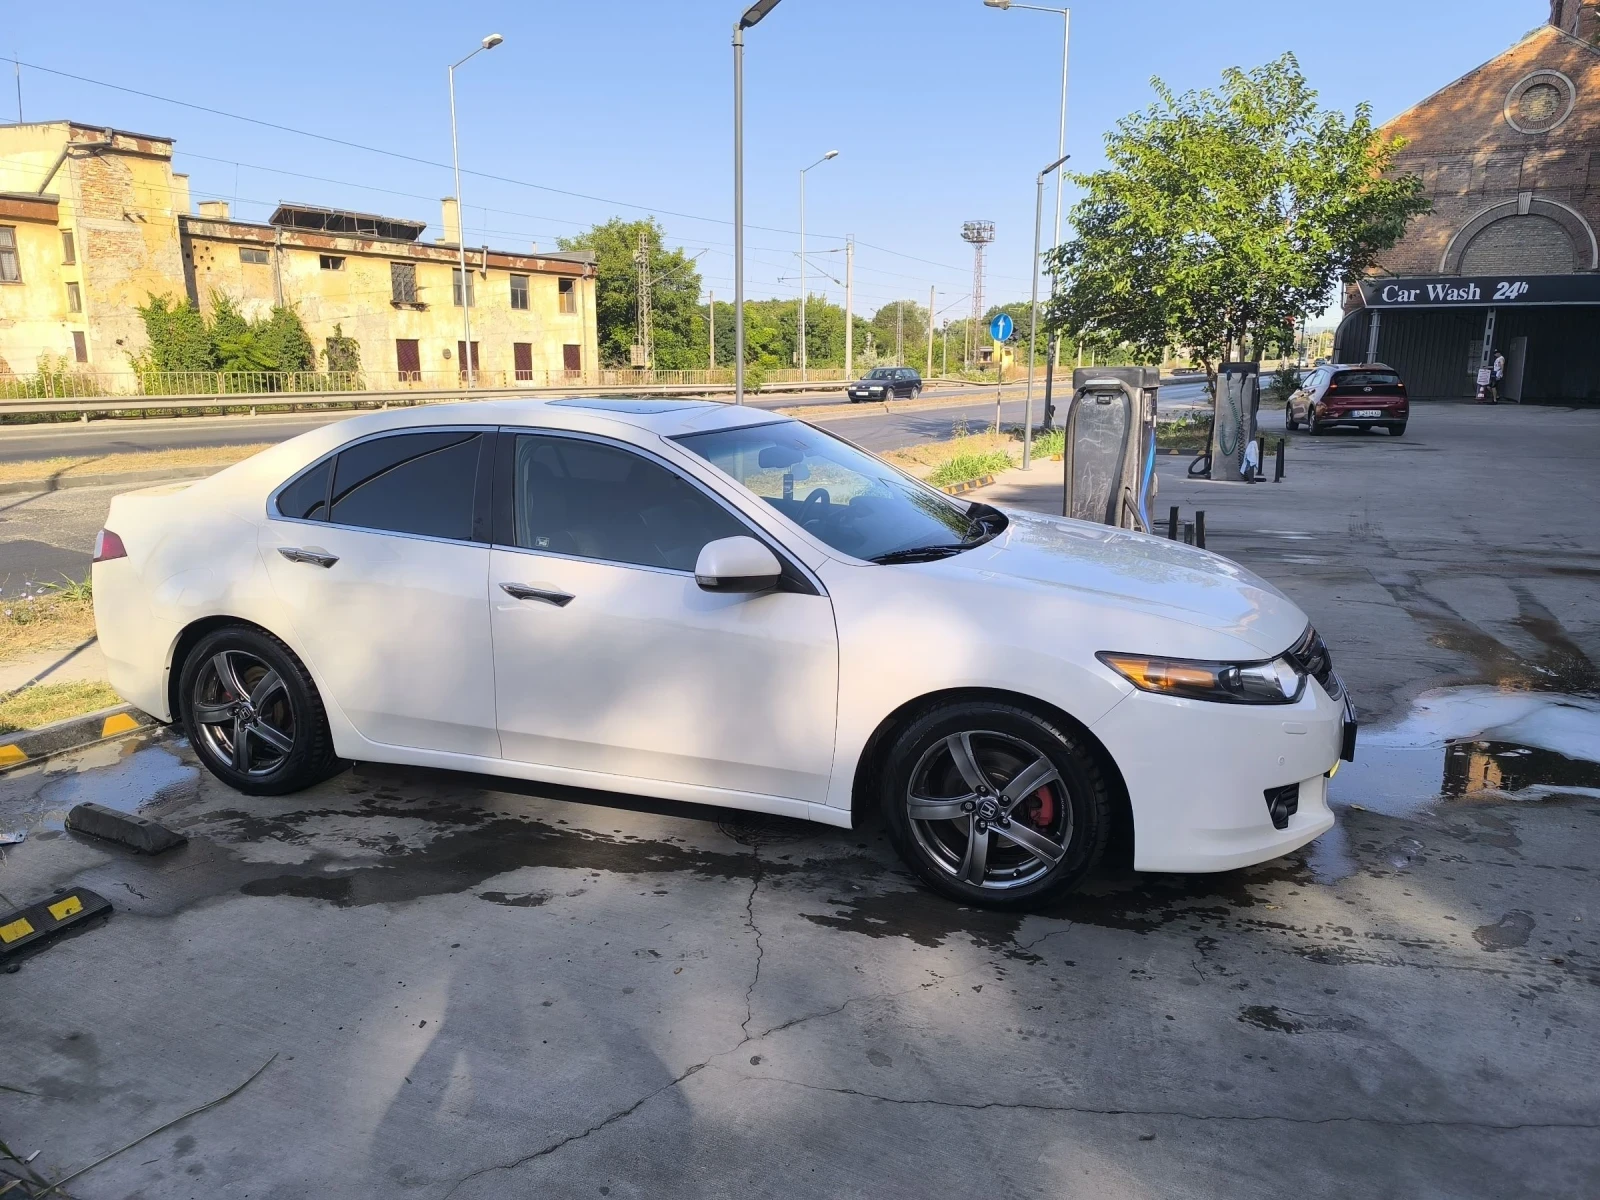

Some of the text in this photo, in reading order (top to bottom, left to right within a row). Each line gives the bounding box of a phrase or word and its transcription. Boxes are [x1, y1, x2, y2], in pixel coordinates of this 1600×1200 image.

[1382, 281, 1529, 302] Car Wash 24h
